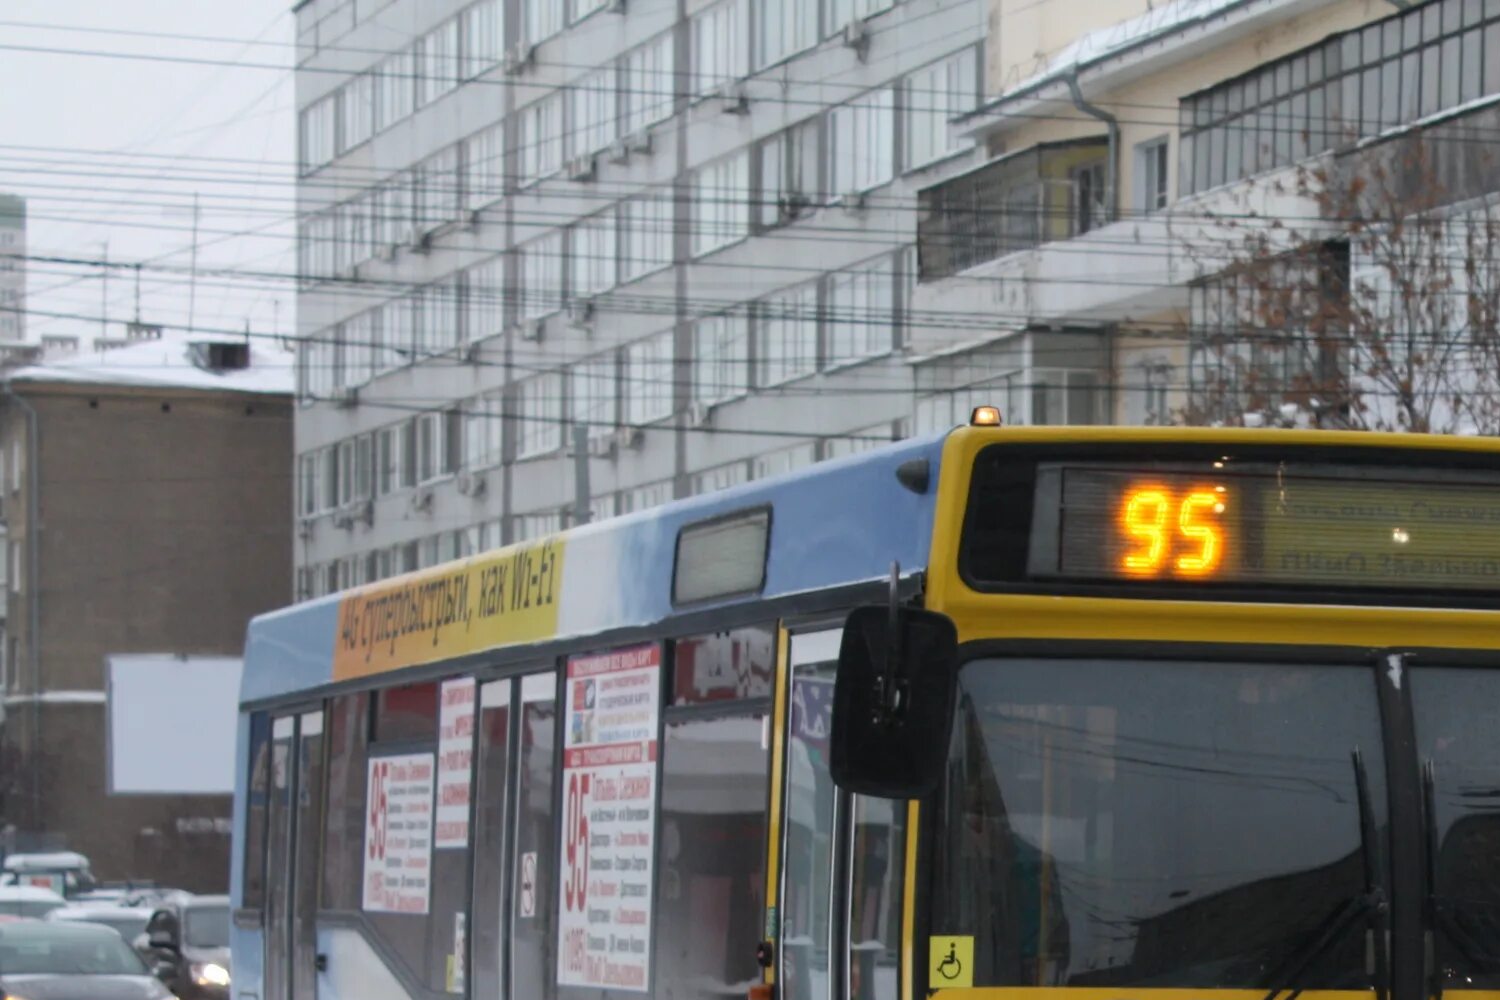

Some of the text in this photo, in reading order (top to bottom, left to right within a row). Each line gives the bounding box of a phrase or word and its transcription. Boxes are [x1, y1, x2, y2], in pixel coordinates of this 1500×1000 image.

[1120, 486, 1221, 572] 95
[478, 563, 508, 619] как
[369, 762, 388, 860] 95
[565, 772, 590, 912] 95
